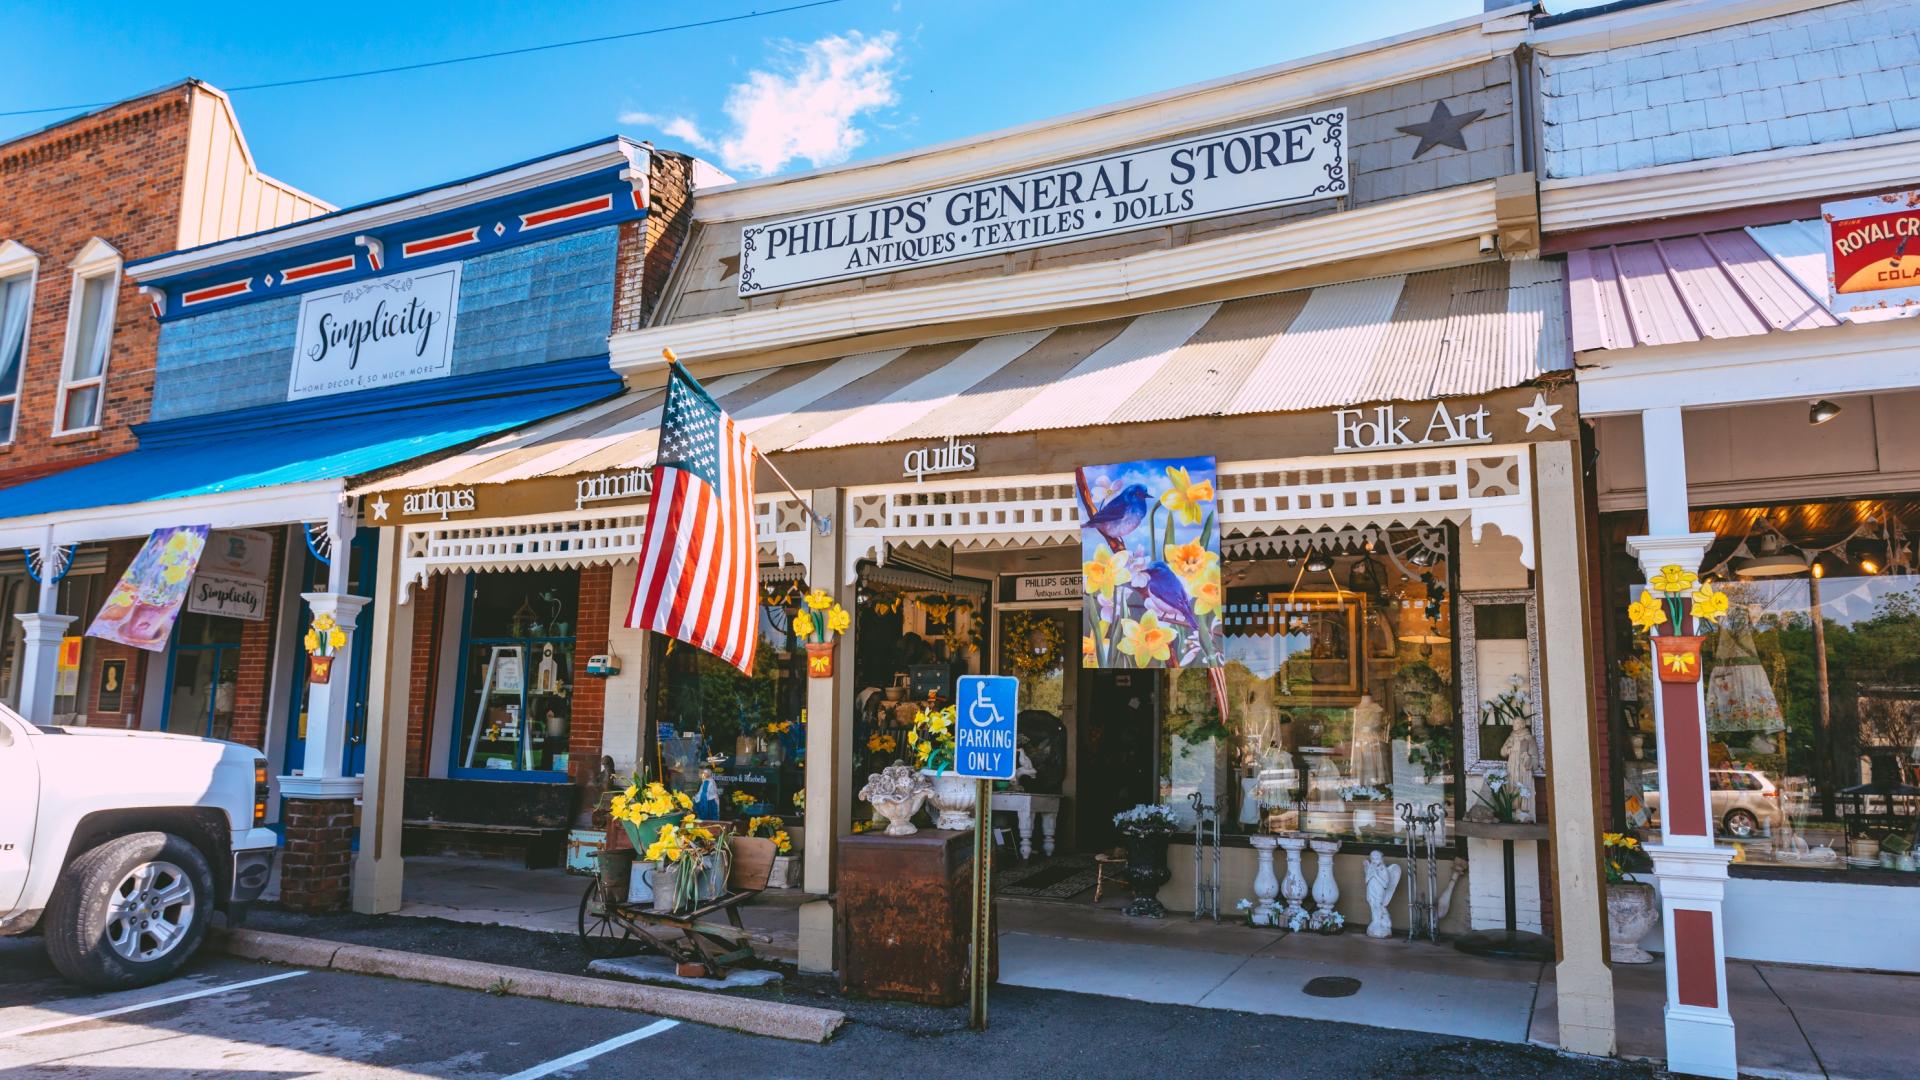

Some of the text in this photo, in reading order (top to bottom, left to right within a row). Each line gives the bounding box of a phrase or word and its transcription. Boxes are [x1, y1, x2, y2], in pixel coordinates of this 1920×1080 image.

[765, 125, 1315, 261] PHILLIPS' GENERAL STORE
[845, 189, 1194, 270] ANTIQUES TEXTILES DOLLS
[1835, 220, 1895, 256] ROYAL
[1878, 267, 1920, 281] COLA
[307, 296, 442, 370] Simplicity
[302, 385, 324, 393] HOME
[327, 379, 354, 389] DECOR
[367, 374, 378, 383] SO
[382, 370, 405, 380] MUCH
[410, 366, 433, 376] MORE
[1332, 401, 1493, 449] Folk Art
[903, 436, 976, 486] quilts
[403, 487, 475, 520] antiques
[575, 468, 653, 511] primitiv
[197, 583, 259, 613] Simplicity
[1025, 576, 1083, 588] PHILLIPS GENER
[959, 728, 1012, 749] PARKING
[968, 751, 1001, 772] ONLY
